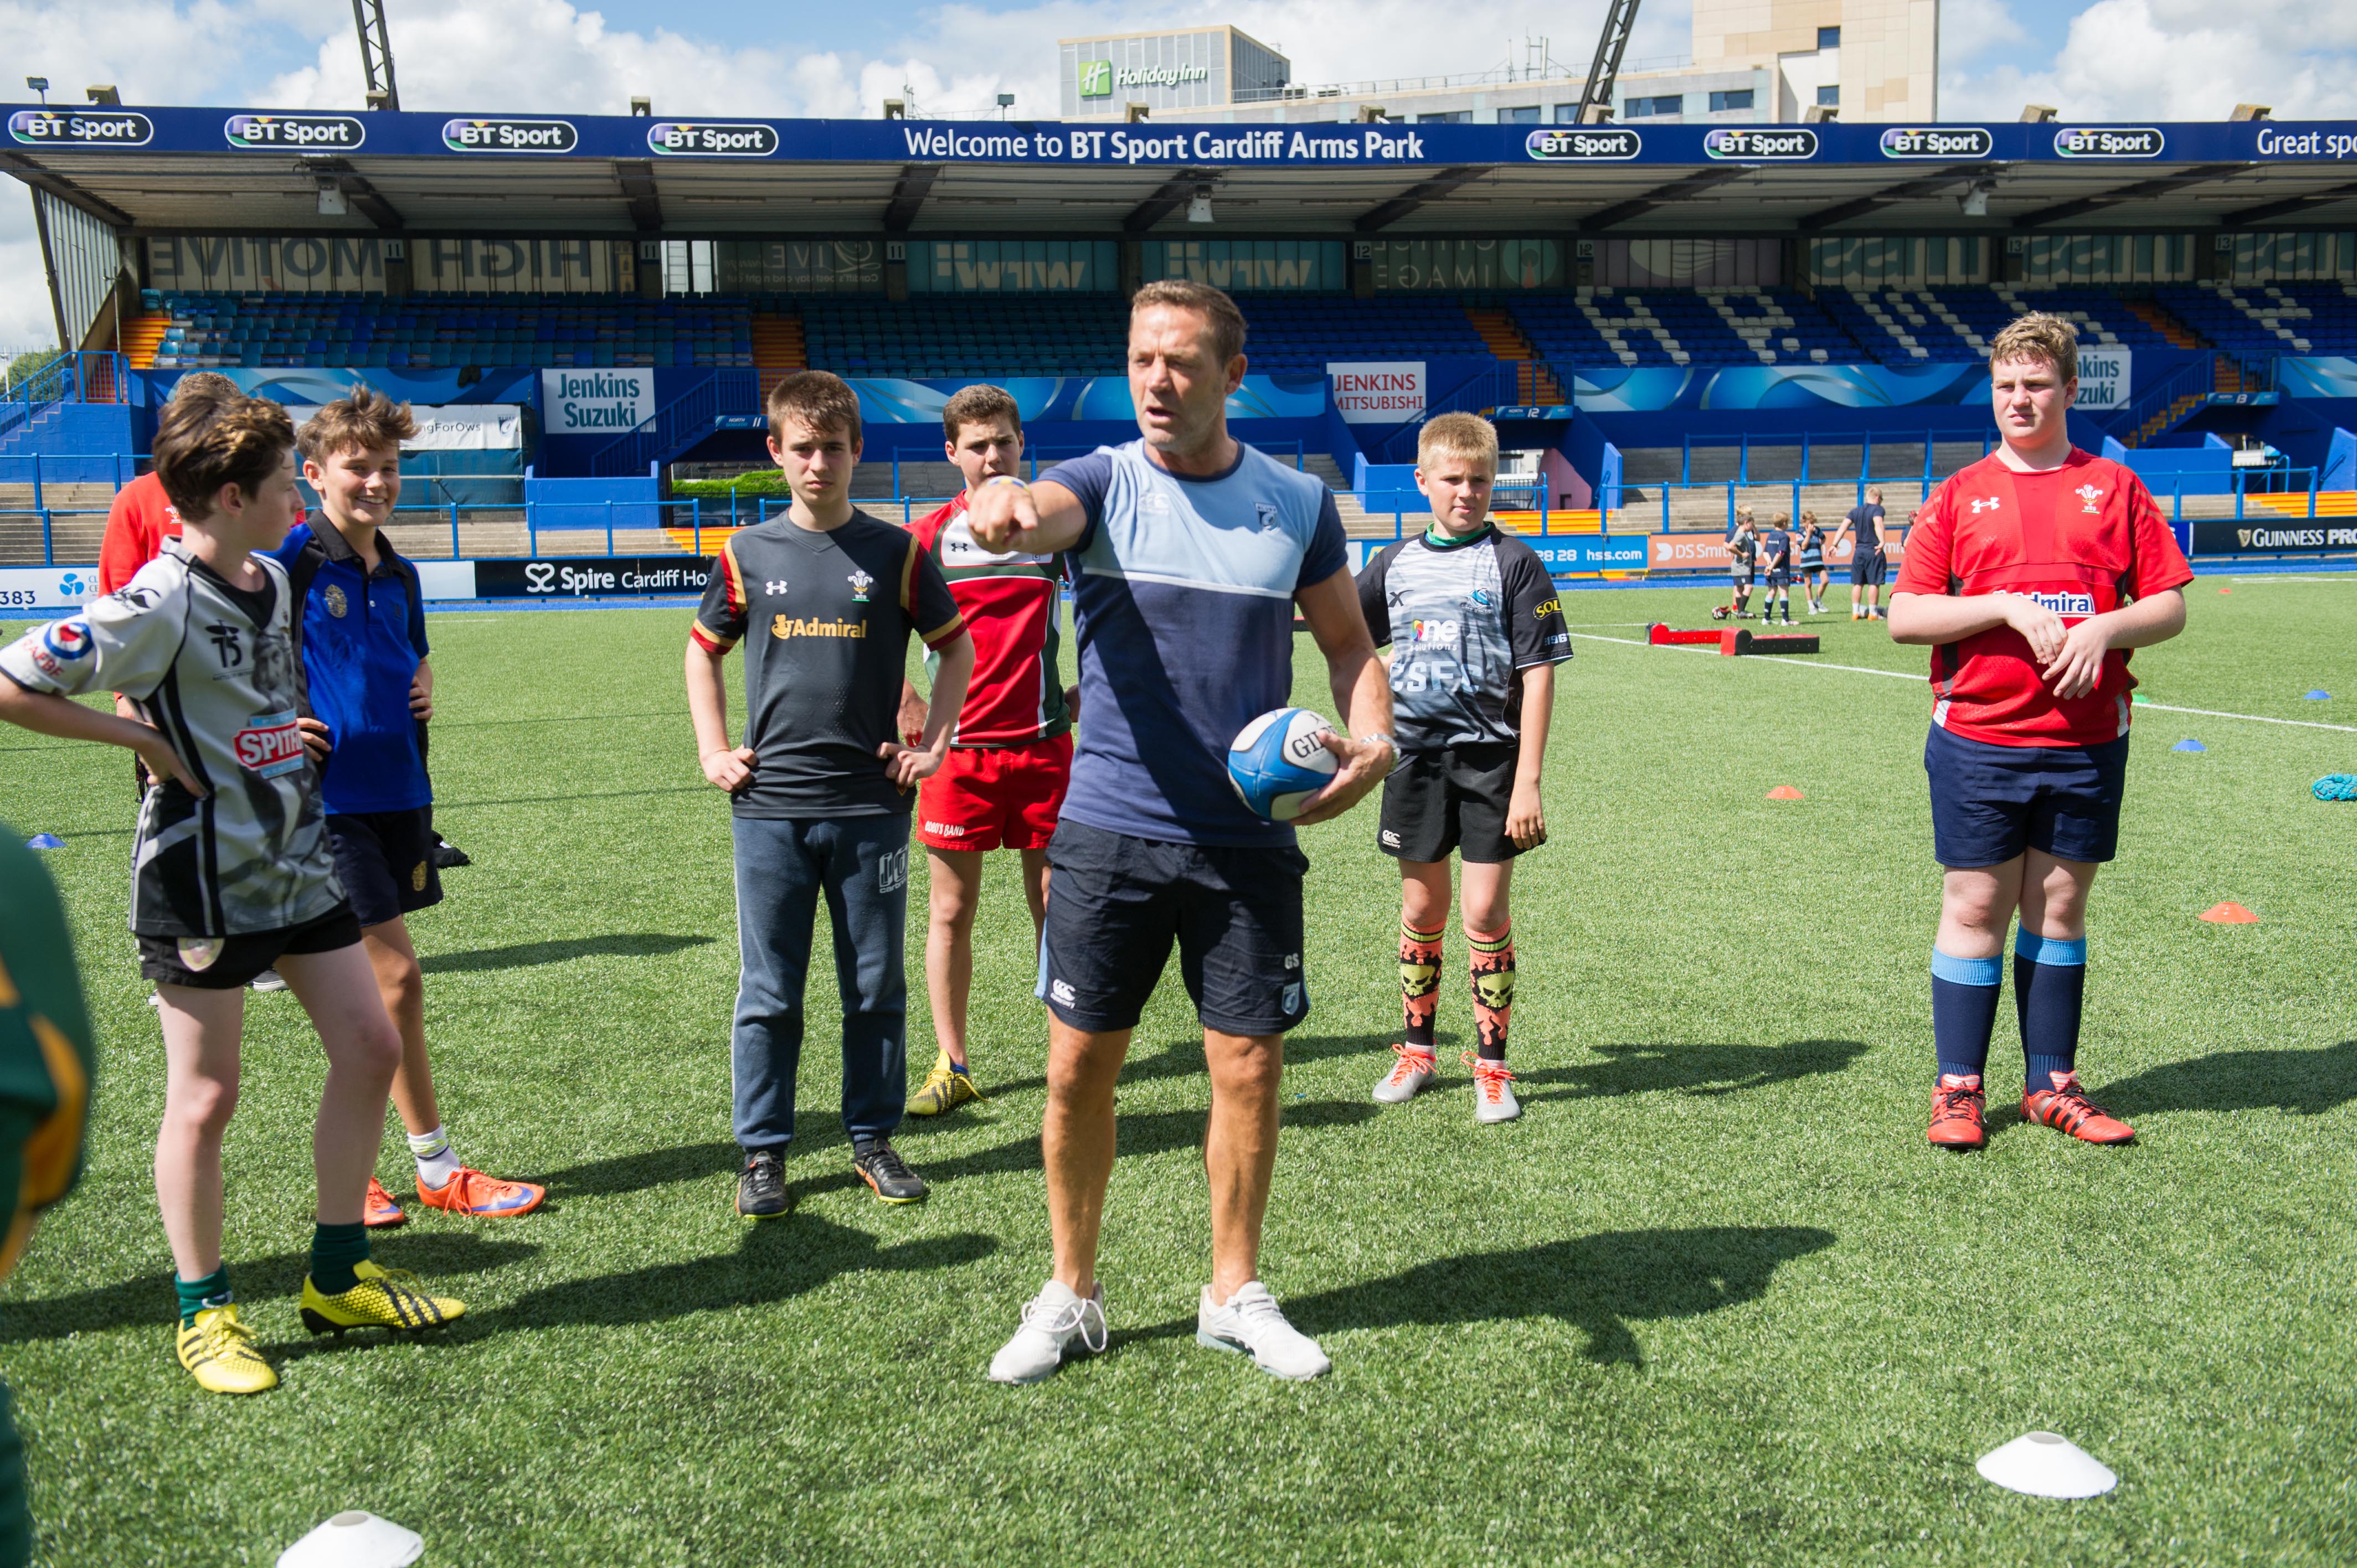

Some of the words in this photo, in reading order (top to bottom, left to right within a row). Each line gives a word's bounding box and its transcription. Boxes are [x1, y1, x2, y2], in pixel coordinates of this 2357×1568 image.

[1115, 65, 1178, 86] Holiday
[1179, 63, 1206, 80] Inn
[28, 119, 66, 137] BT
[70, 118, 136, 140] Sport
[243, 122, 280, 140] BT
[284, 122, 348, 143] Sport
[460, 126, 496, 143] BT
[500, 125, 562, 147] Sport
[665, 131, 699, 147] BT
[703, 130, 763, 151] Sport
[904, 128, 1028, 157] Welcome
[1034, 133, 1063, 157] to
[1071, 132, 1105, 158] BT
[1111, 131, 1188, 163] Sport
[1194, 132, 1283, 159] Cardiff
[1288, 132, 1358, 158] Arms
[1365, 131, 1424, 158] Park
[1541, 137, 1572, 152] BT
[1574, 136, 1627, 155] Sport
[1719, 137, 1749, 151] BT
[1751, 135, 1804, 154] Sport
[1895, 135, 1925, 150] BT
[1927, 134, 1979, 153] Sport
[2068, 135, 2097, 150] BT
[2101, 133, 2150, 153] Sport
[2257, 128, 2321, 154] Great
[890, 245, 903, 259] 11
[1355, 245, 1371, 259] 12
[1578, 243, 1593, 256] 12
[2009, 239, 2022, 253] 13
[2217, 236, 2231, 249] 13
[558, 373, 640, 400] Jenkins
[1335, 374, 1416, 391] JENKINS
[565, 403, 636, 427] Suzuki
[1527, 408, 1540, 417] 12
[2252, 528, 2324, 547] GUINNESS
[1557, 549, 1577, 561] 28
[1587, 549, 1643, 561] hss.com
[1676, 543, 1694, 559] DS
[562, 567, 615, 595] Spire
[622, 569, 680, 589] Cardiff
[792, 617, 867, 638] Admiral
[1409, 642, 1457, 651] solutions
[1547, 633, 1569, 646] 196
[944, 824, 964, 837] BAND
[1284, 953, 1300, 969] GS
